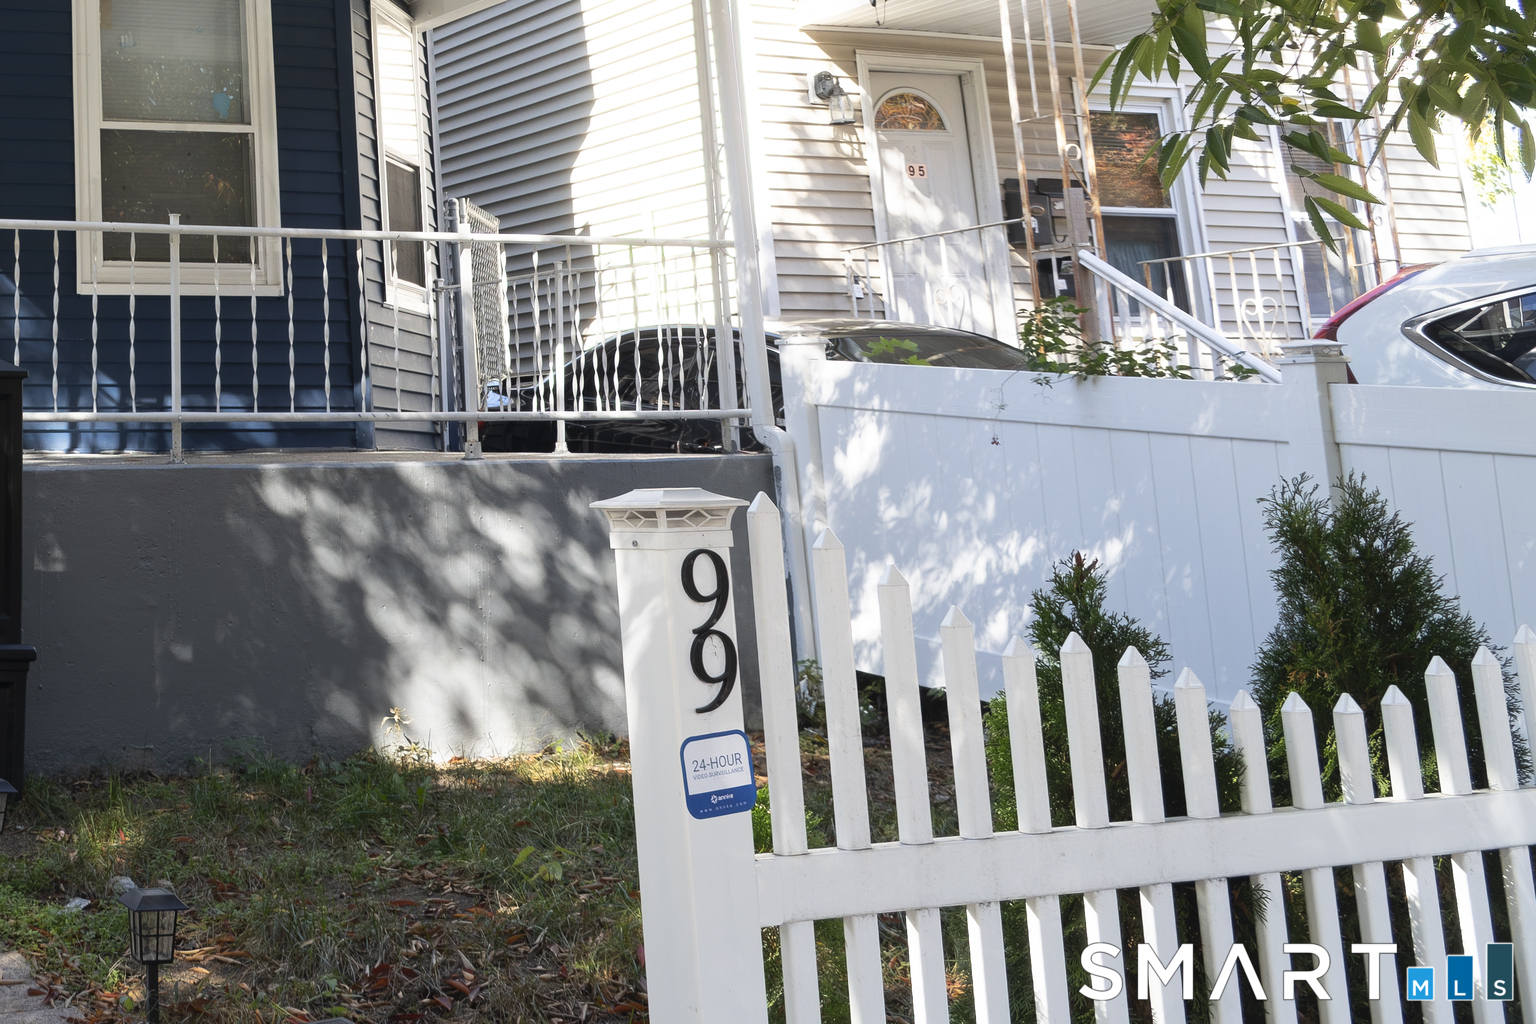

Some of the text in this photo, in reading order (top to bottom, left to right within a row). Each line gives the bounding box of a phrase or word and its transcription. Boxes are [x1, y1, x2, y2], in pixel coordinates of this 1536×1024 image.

[908, 165, 926, 177] 95
[691, 752, 743, 773] 24-HOUR
[692, 766, 744, 781] VIDEO SURVEILLANCE
[717, 793, 734, 801] annke
